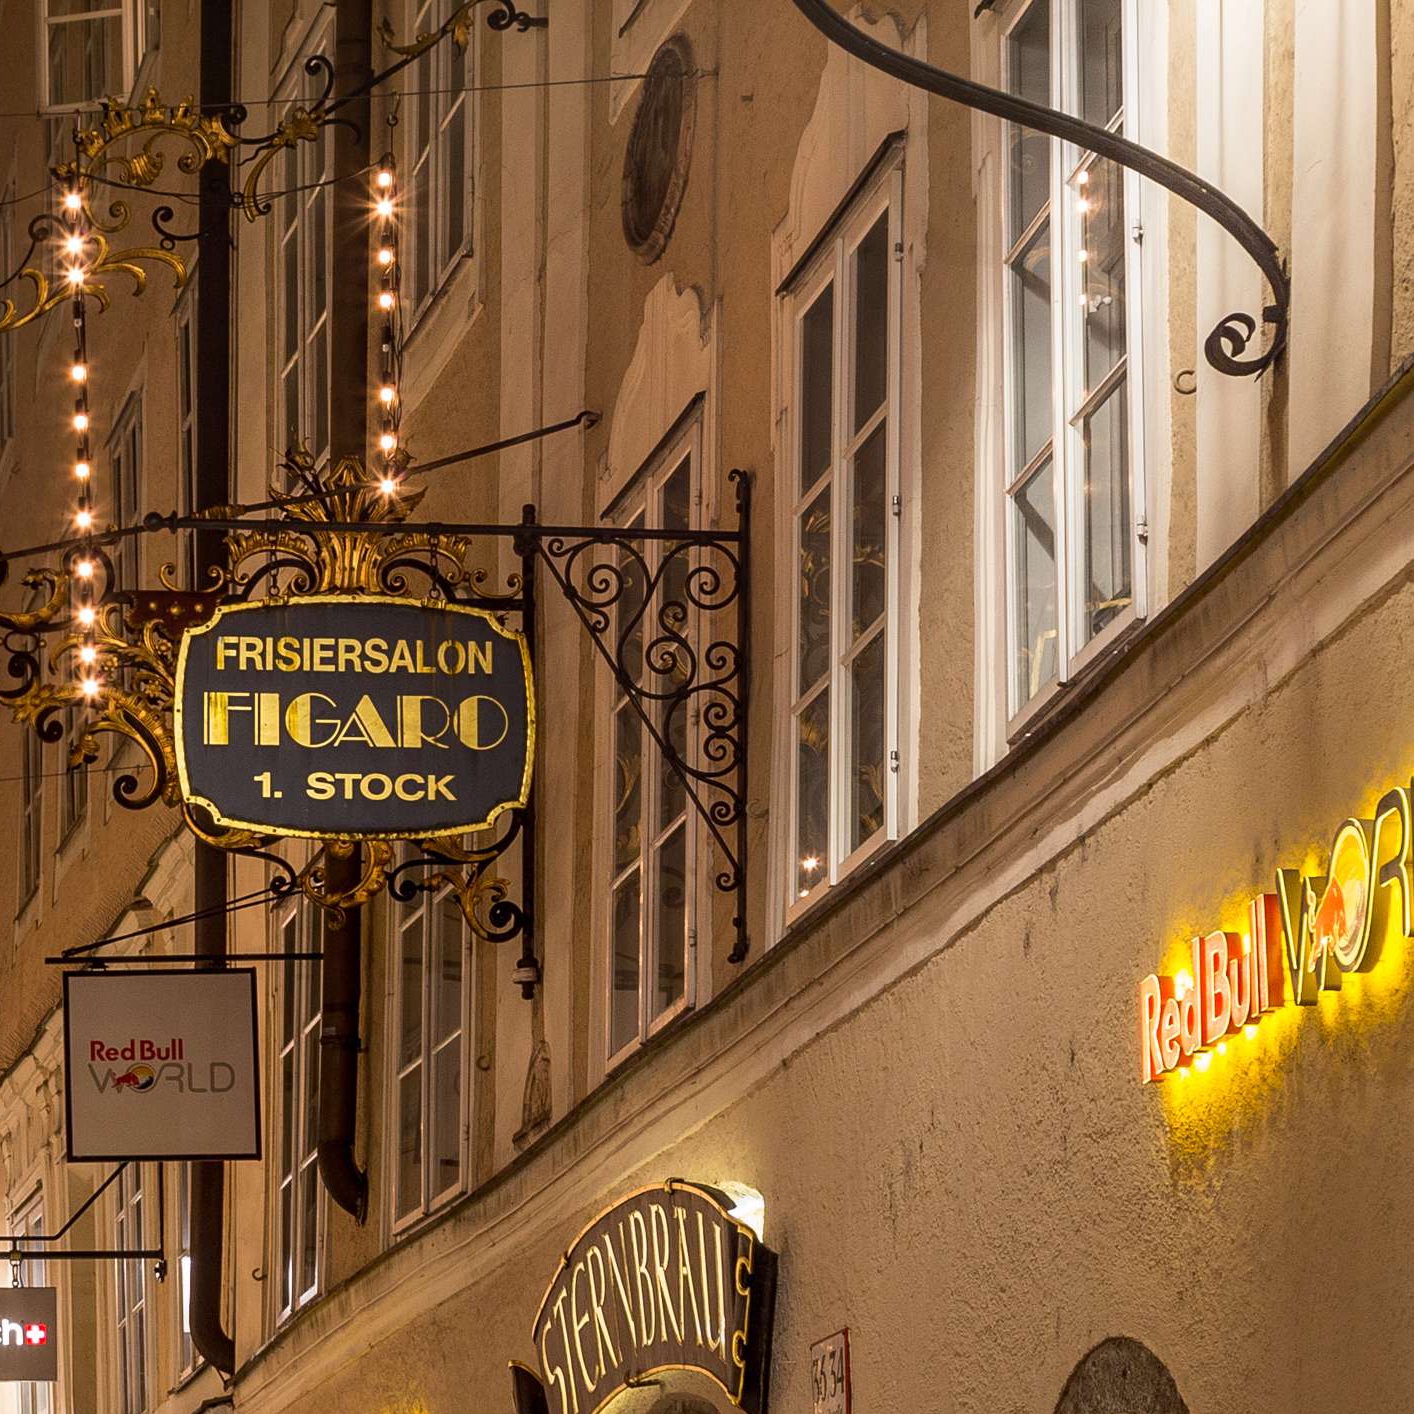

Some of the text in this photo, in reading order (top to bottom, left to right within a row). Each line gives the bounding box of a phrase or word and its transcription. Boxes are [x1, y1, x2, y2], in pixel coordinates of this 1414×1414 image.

[216, 636, 493, 675] FRISIERSALON
[204, 691, 509, 750] FIGARO
[254, 771, 457, 801] 1. STOCK
[1140, 936, 1202, 1085] Red
[1203, 893, 1284, 1045] Bull
[90, 1038, 184, 1062] Red Bull
[88, 1062, 235, 1093] WORLD
